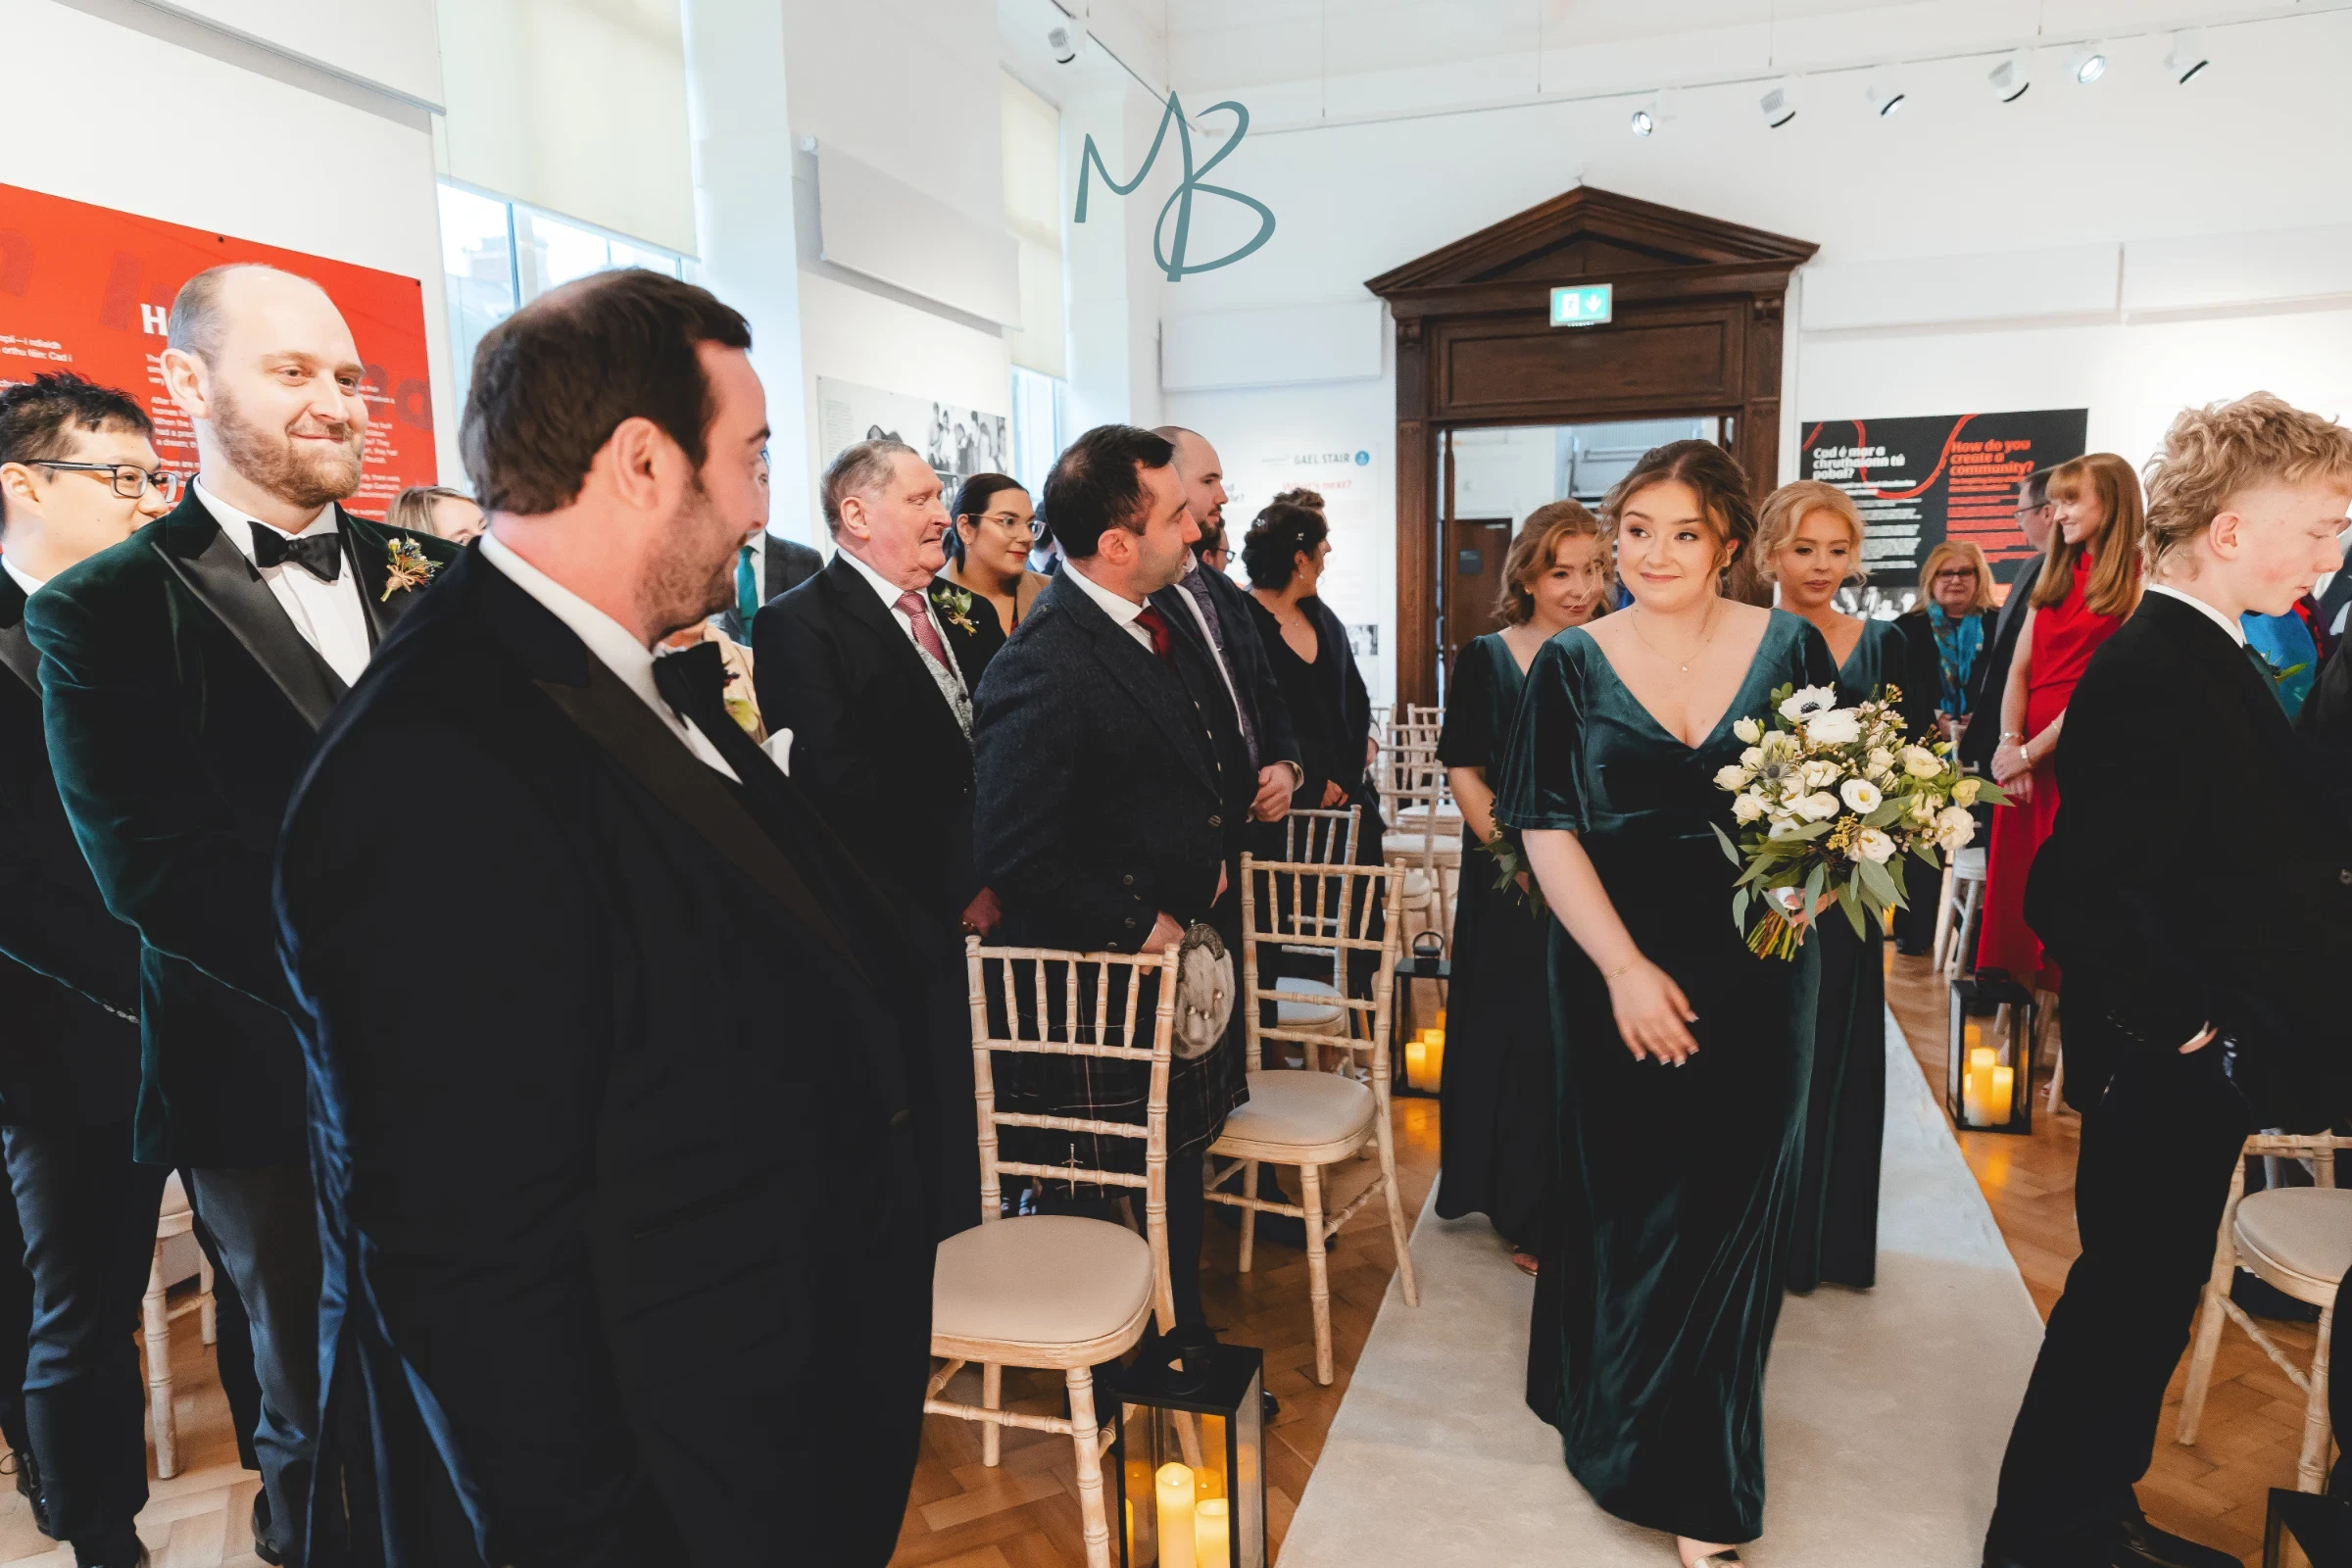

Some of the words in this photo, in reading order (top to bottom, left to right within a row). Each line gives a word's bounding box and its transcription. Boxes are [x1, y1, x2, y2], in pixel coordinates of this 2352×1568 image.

[140, 303, 170, 336] H
[1813, 446, 1838, 460] Cad
[1848, 446, 1876, 458] mar
[1876, 446, 1886, 457] a
[1951, 440, 1984, 453] How
[1984, 439, 2003, 452] do
[2004, 439, 2032, 454] you
[1294, 454, 1318, 466] GAEL
[1322, 453, 1350, 464] STAIR
[1950, 452, 1993, 466] create
[1994, 452, 2005, 464] a
[1813, 467, 1855, 480] pobal?
[1949, 460, 2035, 477] community?
